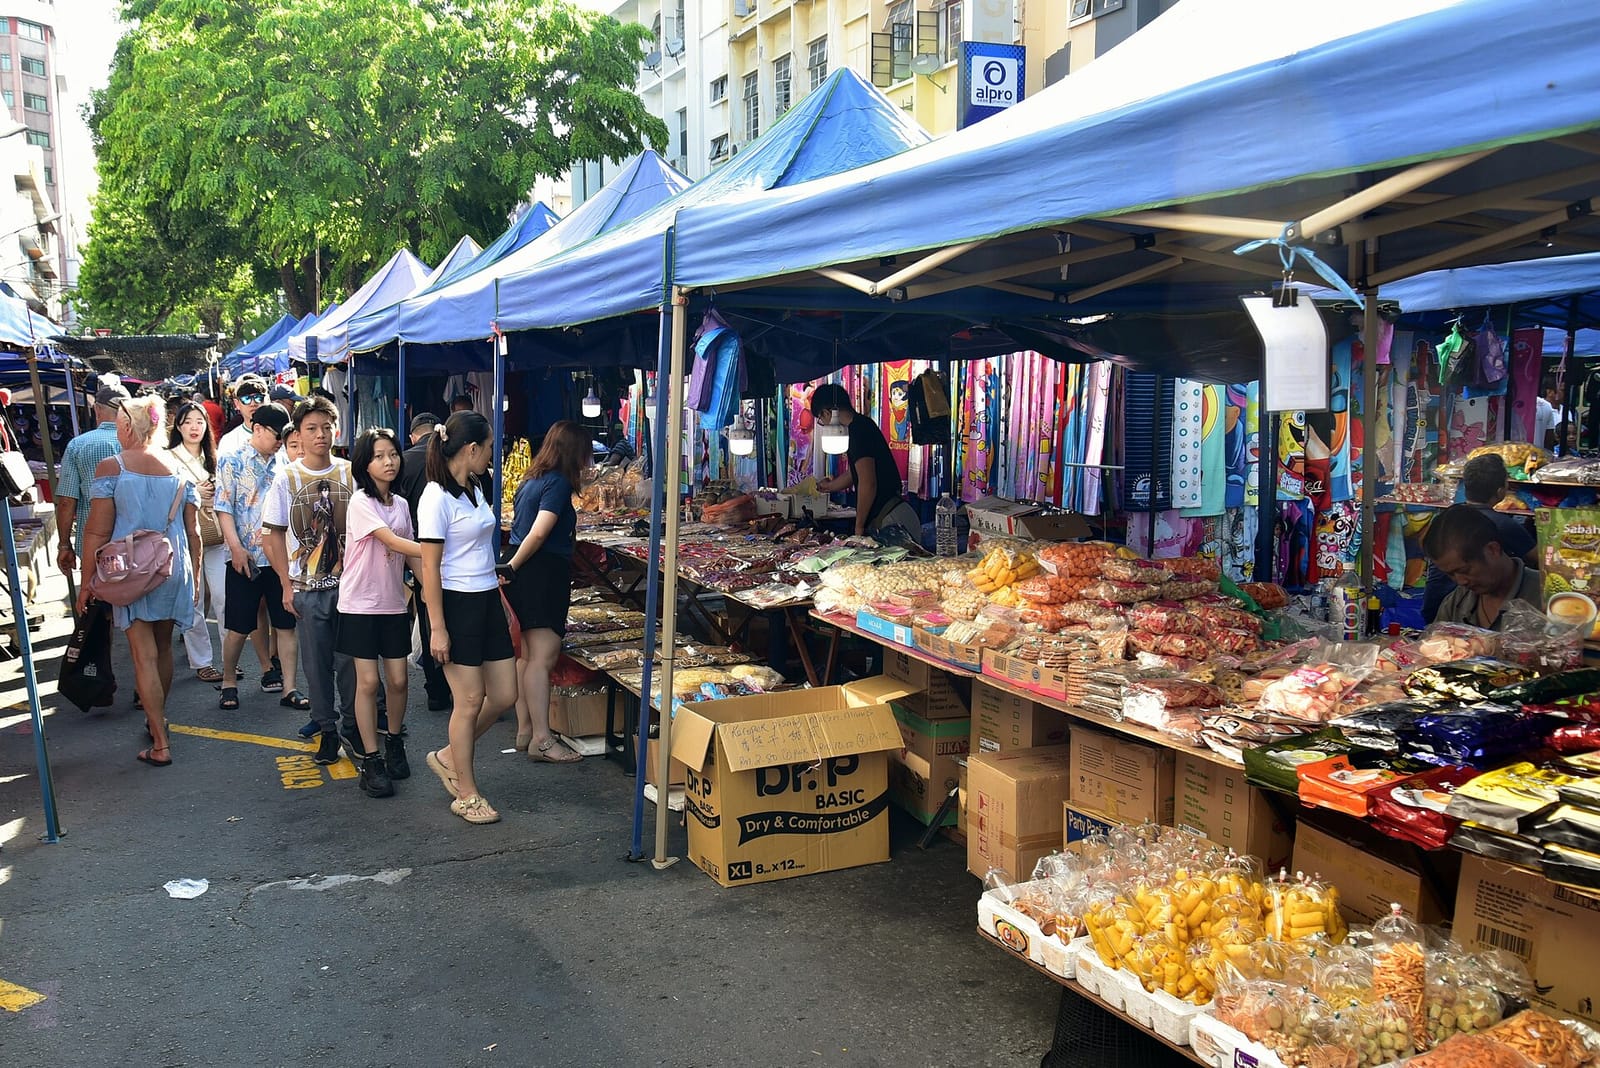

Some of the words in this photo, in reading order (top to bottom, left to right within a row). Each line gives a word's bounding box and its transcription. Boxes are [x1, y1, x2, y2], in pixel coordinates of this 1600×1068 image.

[976, 86, 1012, 103] alpro
[816, 789, 865, 809] BASIC
[745, 818, 770, 833] Dry
[774, 816, 784, 828] &
[789, 809, 870, 833] Comfortable
[1068, 811, 1086, 836] Party
[730, 863, 751, 878] XL
